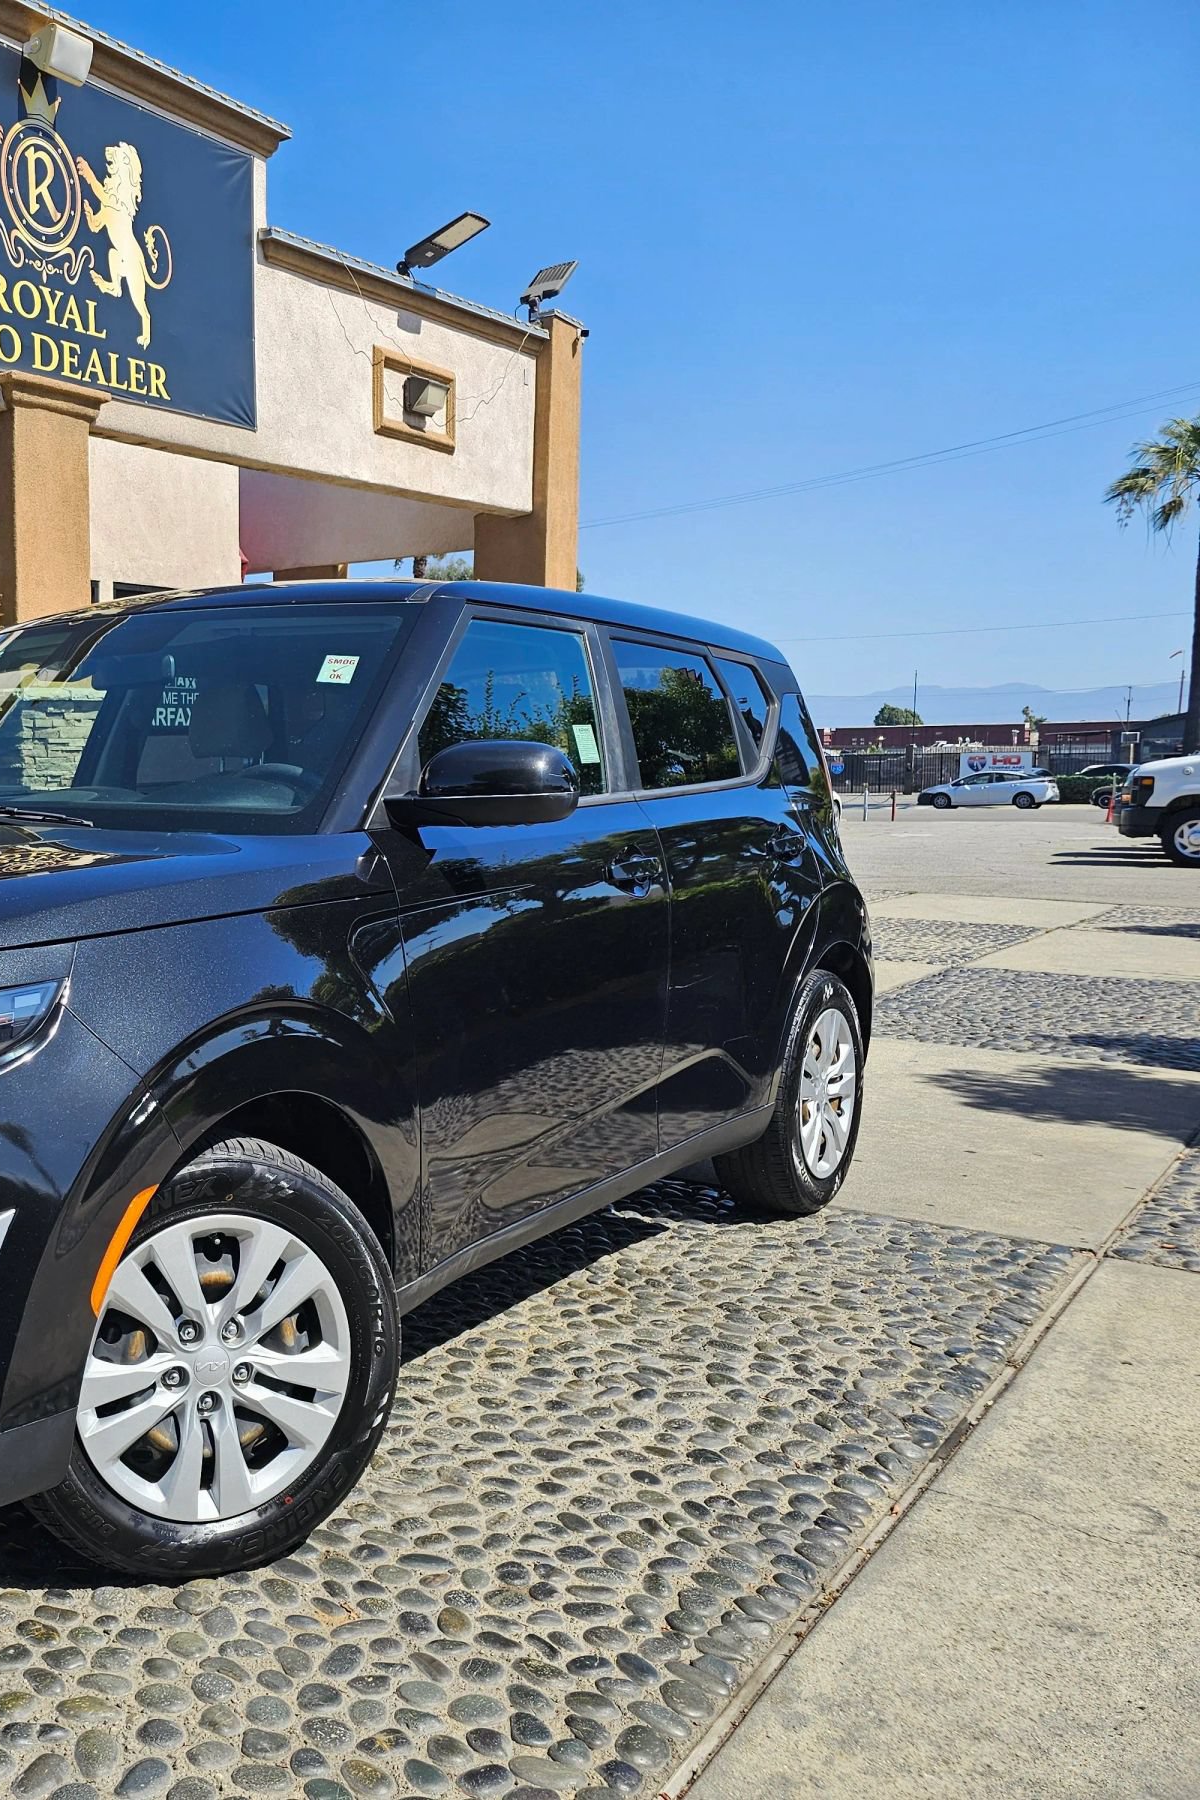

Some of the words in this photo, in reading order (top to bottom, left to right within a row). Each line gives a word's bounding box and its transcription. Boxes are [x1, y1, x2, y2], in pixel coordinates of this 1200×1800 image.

[31, 331, 171, 401] DEALER
[162, 691, 179, 705] ME
[151, 707, 192, 727] RFA
